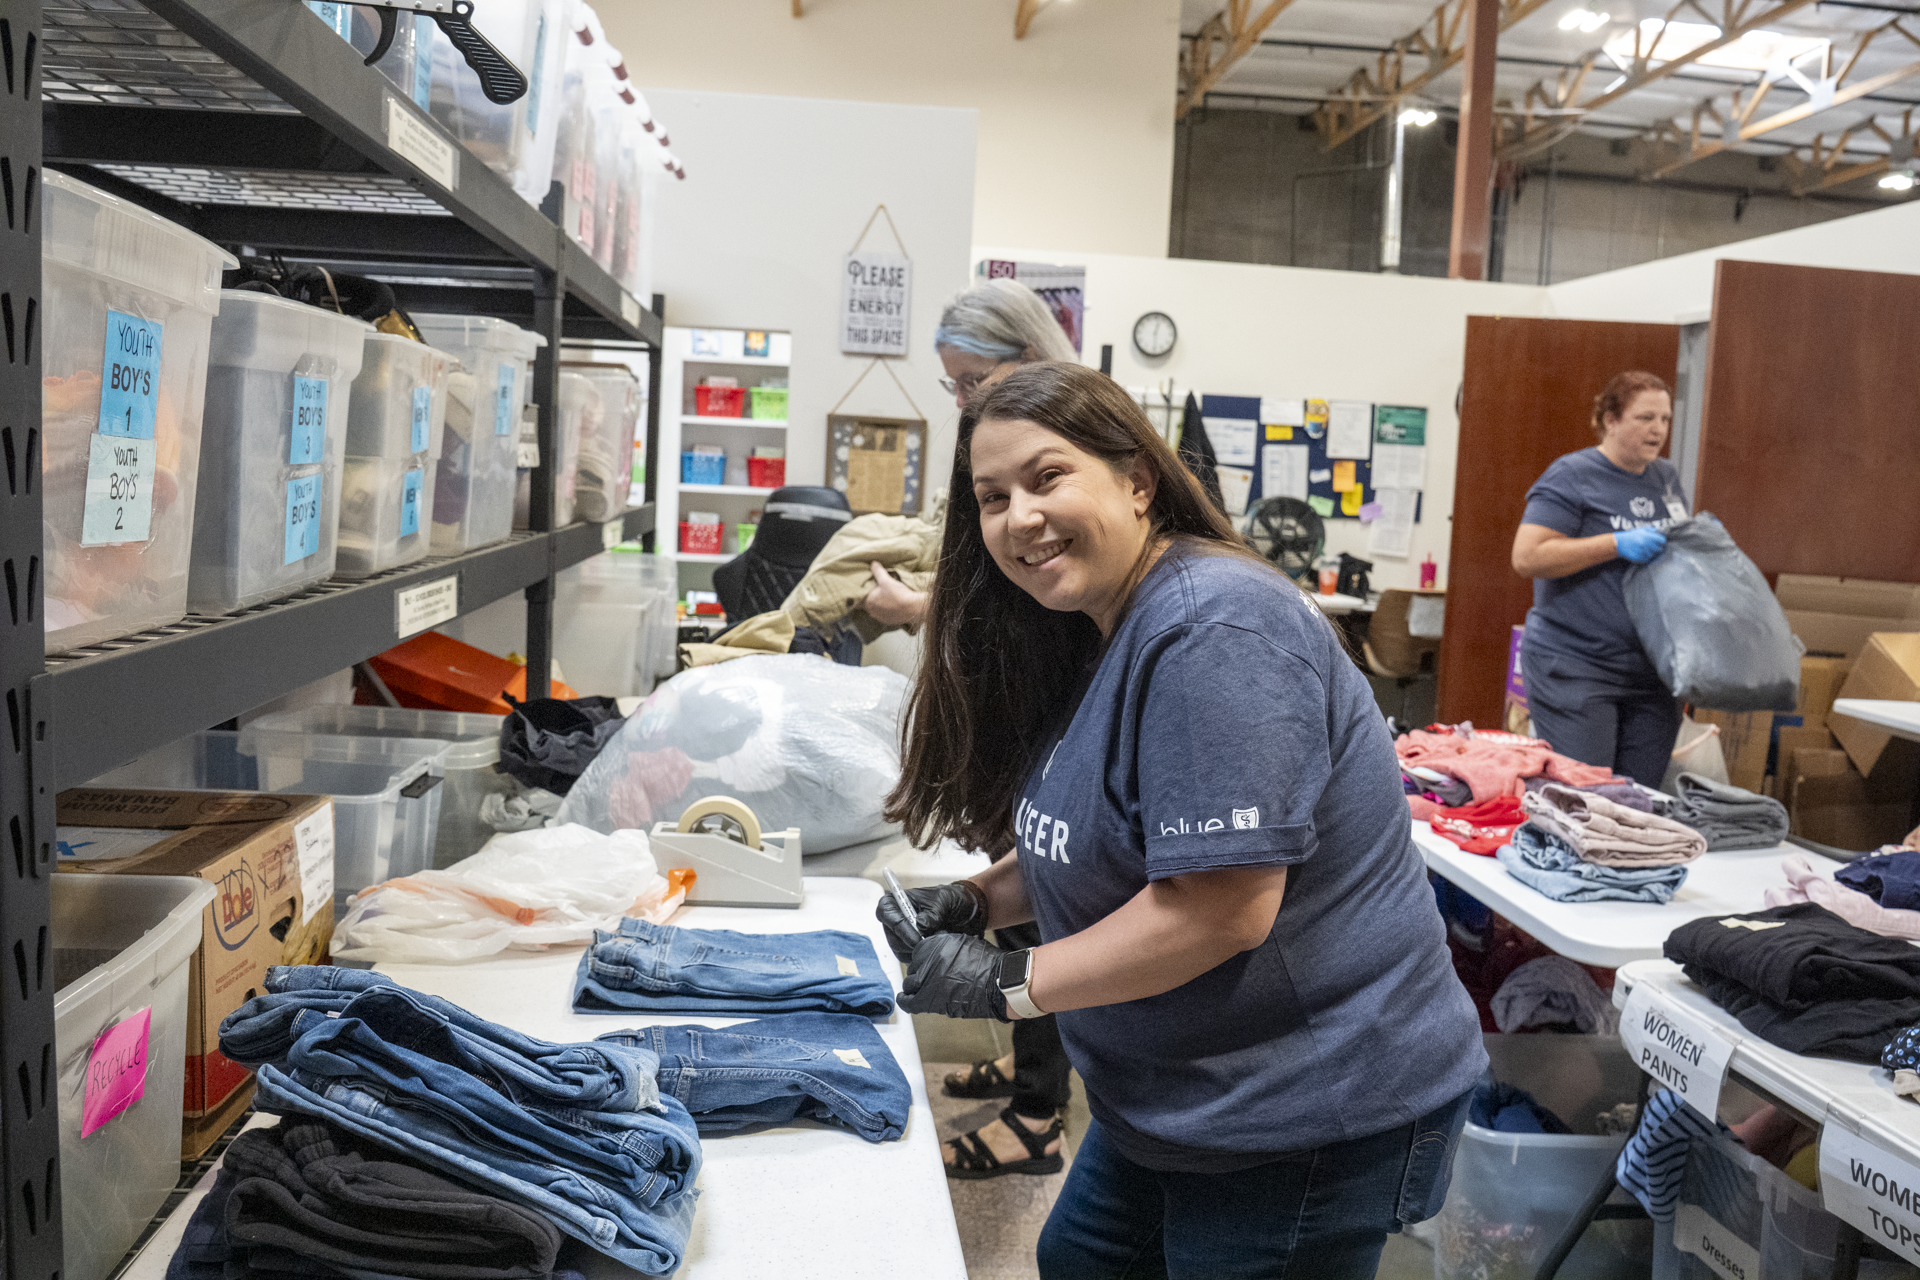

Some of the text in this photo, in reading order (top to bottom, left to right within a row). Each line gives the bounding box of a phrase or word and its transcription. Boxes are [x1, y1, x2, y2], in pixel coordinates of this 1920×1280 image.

[848, 260, 905, 288] PLEASE
[991, 261, 1012, 279] 50
[849, 299, 903, 316] ENERGY
[117, 319, 153, 357] YOUTH
[847, 325, 903, 346] THIS SPACE
[111, 362, 151, 396] BOY'S
[125, 406, 131, 431] 1
[298, 405, 323, 426] BOY'S
[113, 446, 138, 467] YOUTH
[305, 436, 310, 455] 3
[114, 506, 123, 531] 2
[292, 500, 316, 526] BOY'S
[299, 531, 304, 550] 4
[1643, 1011, 1703, 1067] WOMEN
[92, 1037, 142, 1096] RECYCLE
[1641, 1047, 1689, 1094] PANTS
[1850, 1158, 1920, 1217] WOME
[1868, 1206, 1920, 1256] TOPS
[1702, 1235, 1746, 1280] Dresses
